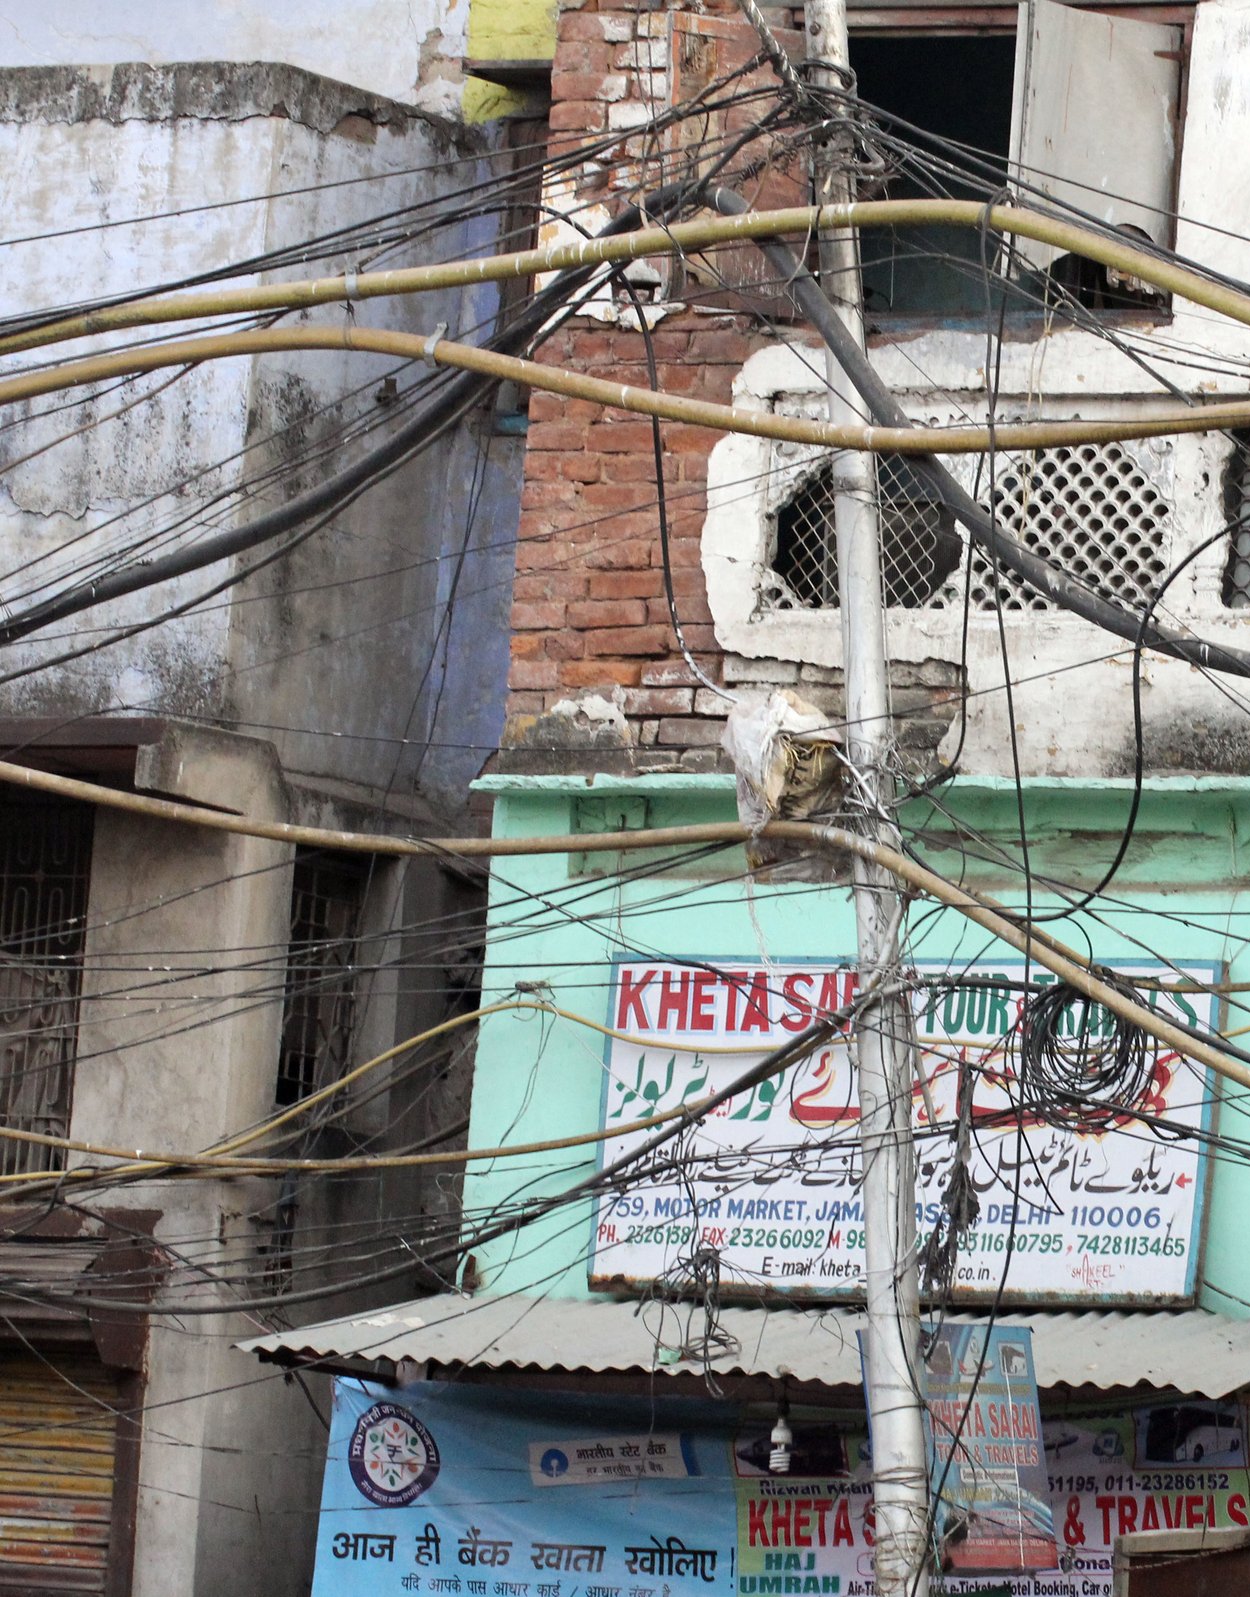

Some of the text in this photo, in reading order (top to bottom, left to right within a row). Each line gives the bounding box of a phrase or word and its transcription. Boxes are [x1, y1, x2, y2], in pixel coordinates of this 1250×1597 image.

[617, 970, 770, 1033] KHETA
[924, 973, 1011, 1035] TOUR
[653, 1198, 721, 1220] MOTOR
[987, 1204, 1052, 1225] DELHI
[928, 1399, 1039, 1441] KHETA SARAI
[973, 1445, 983, 1464] &
[984, 1445, 1040, 1467] TRAVELS
[1105, 1473, 1229, 1493] 011-23286152
[748, 1498, 854, 1548] KHETA
[1063, 1494, 1086, 1546] &
[1096, 1493, 1249, 1546] TRAVELS
[332, 1532, 397, 1563] आज
[415, 1522, 442, 1567] ही
[457, 1525, 513, 1568] बैंक
[530, 1543, 607, 1573] खाता
[624, 1535, 718, 1583] खोलिए
[765, 1552, 816, 1571] HAJ
[401, 1572, 421, 1592] यदि
[428, 1574, 462, 1594] आपके
[467, 1579, 487, 1596] पास
[493, 1581, 531, 1597] आधार
[537, 1578, 562, 1597] कार्ड
[585, 1585, 623, 1597] आधार
[739, 1575, 840, 1595] UMRAH
[1033, 1580, 1080, 1597] Booking,
[1082, 1580, 1100, 1597] Car
